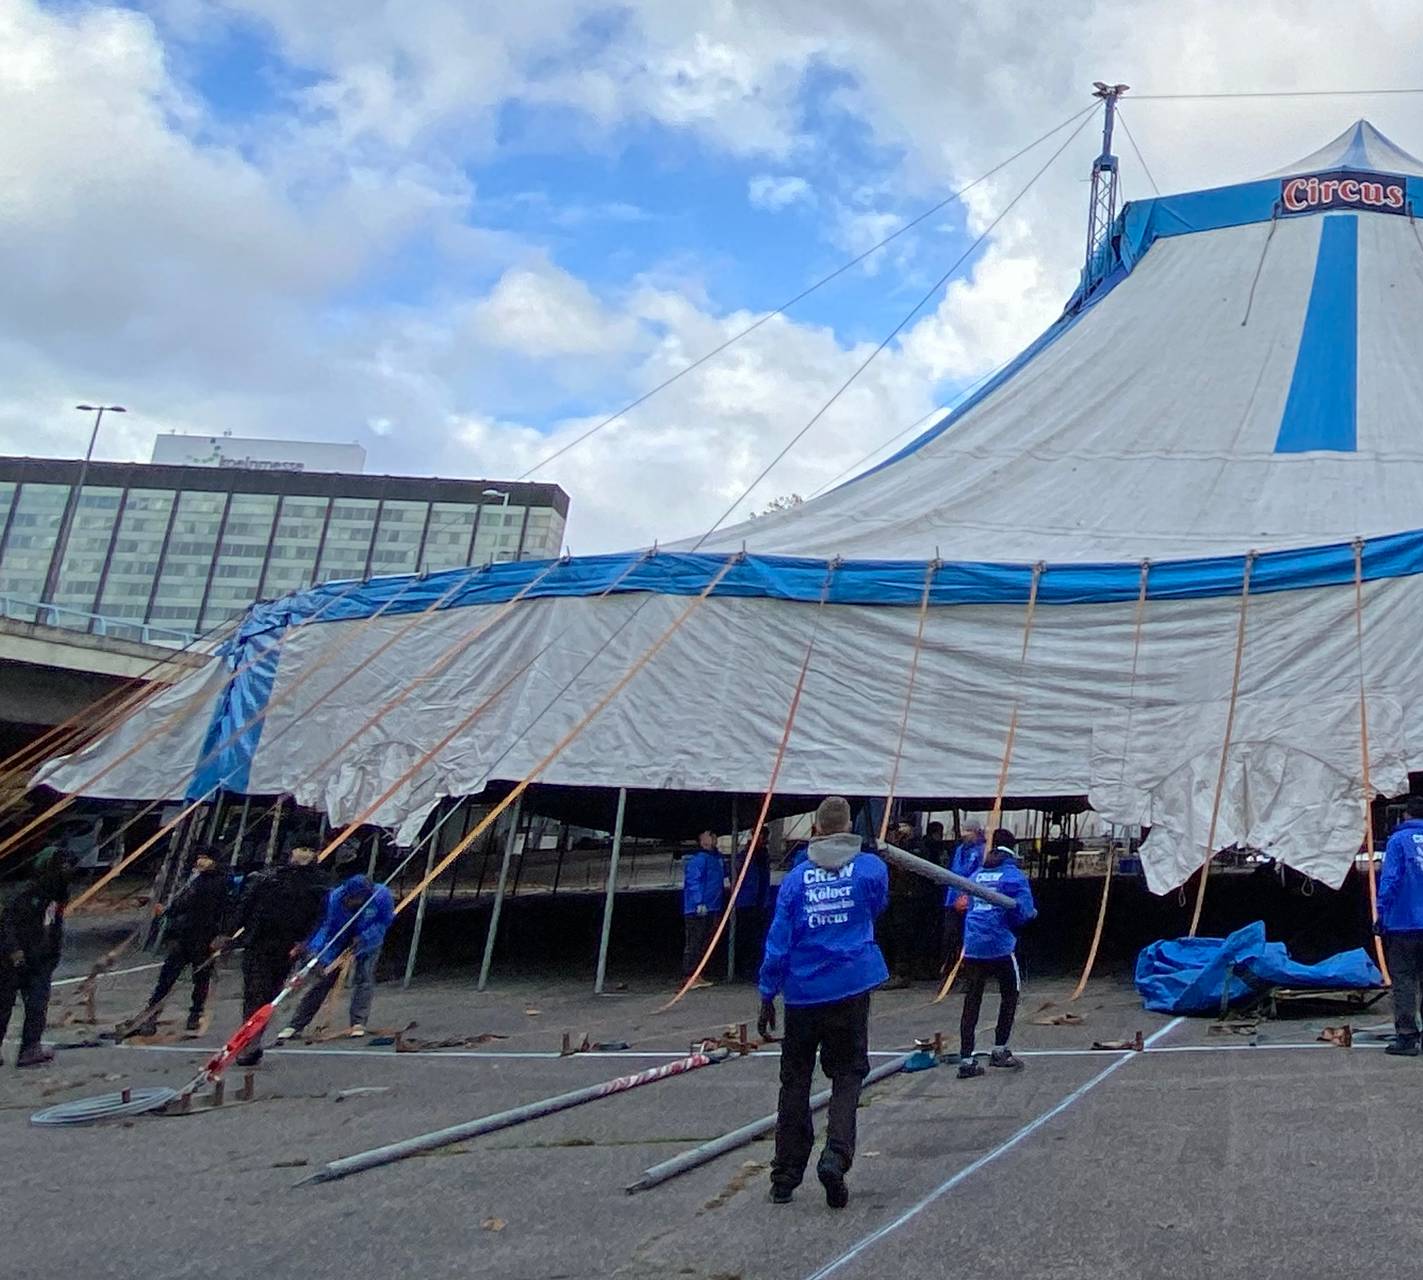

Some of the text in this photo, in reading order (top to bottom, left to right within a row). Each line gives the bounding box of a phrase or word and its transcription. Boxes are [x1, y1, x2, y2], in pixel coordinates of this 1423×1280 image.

[1283, 178, 1404, 210] Circus
[803, 863, 854, 884] CREW
[808, 912, 848, 928] Circus
